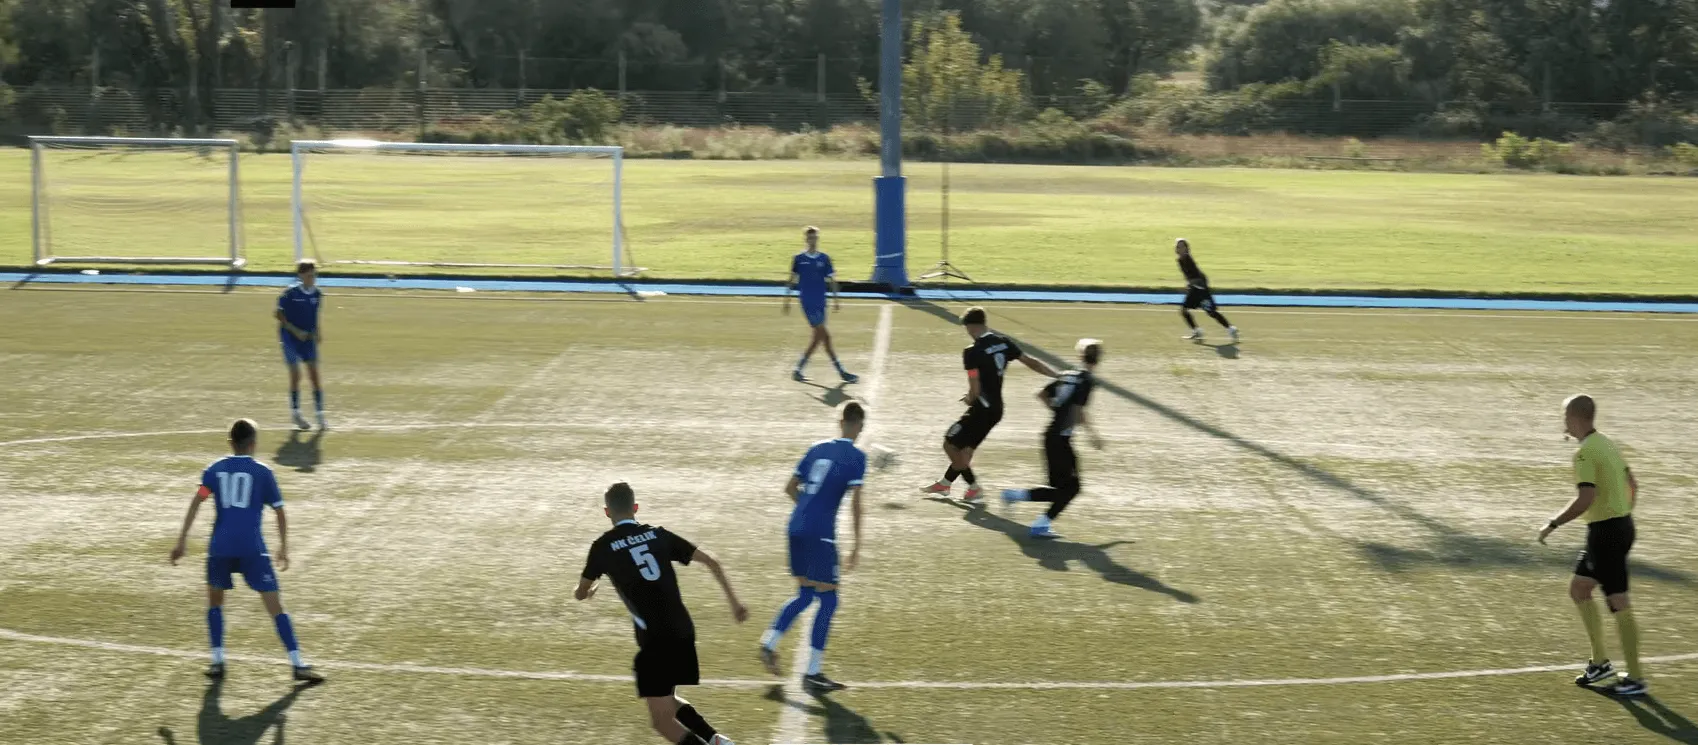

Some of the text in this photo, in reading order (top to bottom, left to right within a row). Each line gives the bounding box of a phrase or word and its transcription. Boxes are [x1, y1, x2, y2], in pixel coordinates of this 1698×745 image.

[216, 471, 254, 509] 10
[807, 458, 833, 495] 9
[611, 530, 657, 552] NK ČELIK
[629, 544, 661, 581] 5
